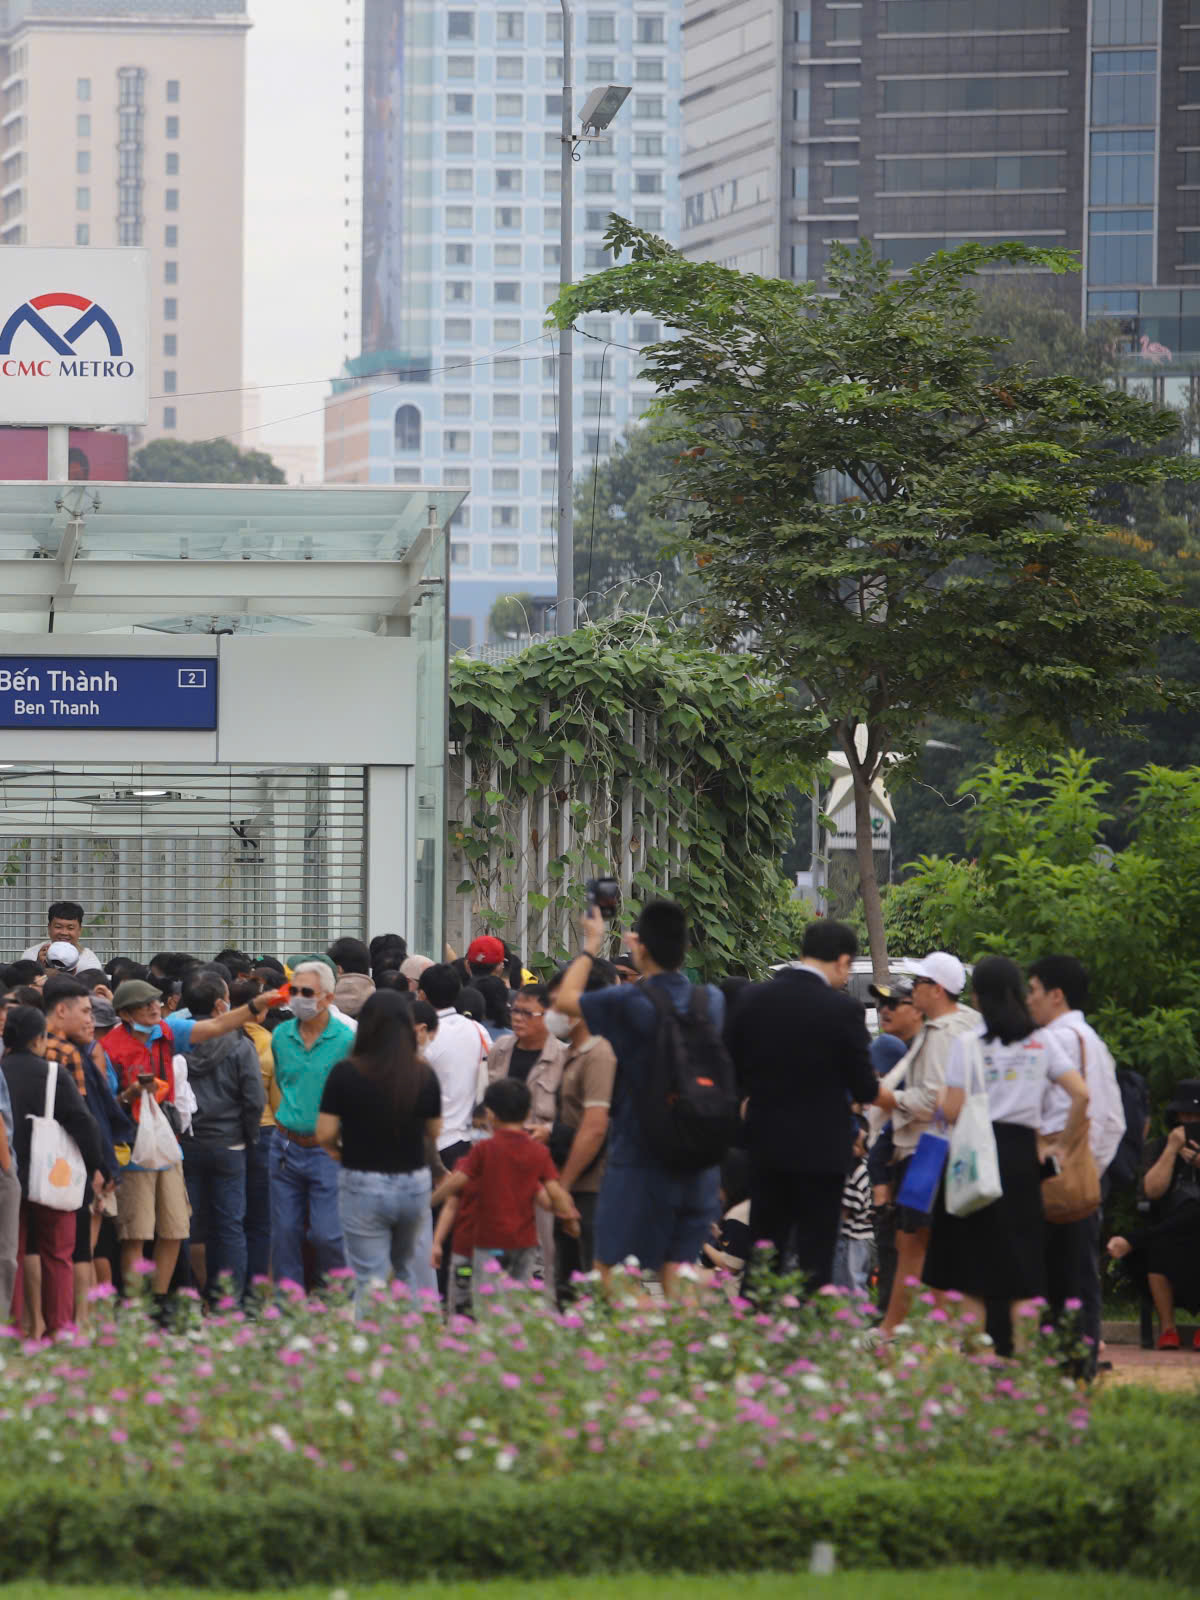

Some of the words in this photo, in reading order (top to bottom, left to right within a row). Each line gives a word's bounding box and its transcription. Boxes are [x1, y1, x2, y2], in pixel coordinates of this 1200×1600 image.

[59, 360, 135, 378] METRO
[46, 669, 118, 692] Thành
[188, 672, 196, 684] 2
[14, 699, 45, 715] Ben
[49, 699, 100, 715] Thanh
